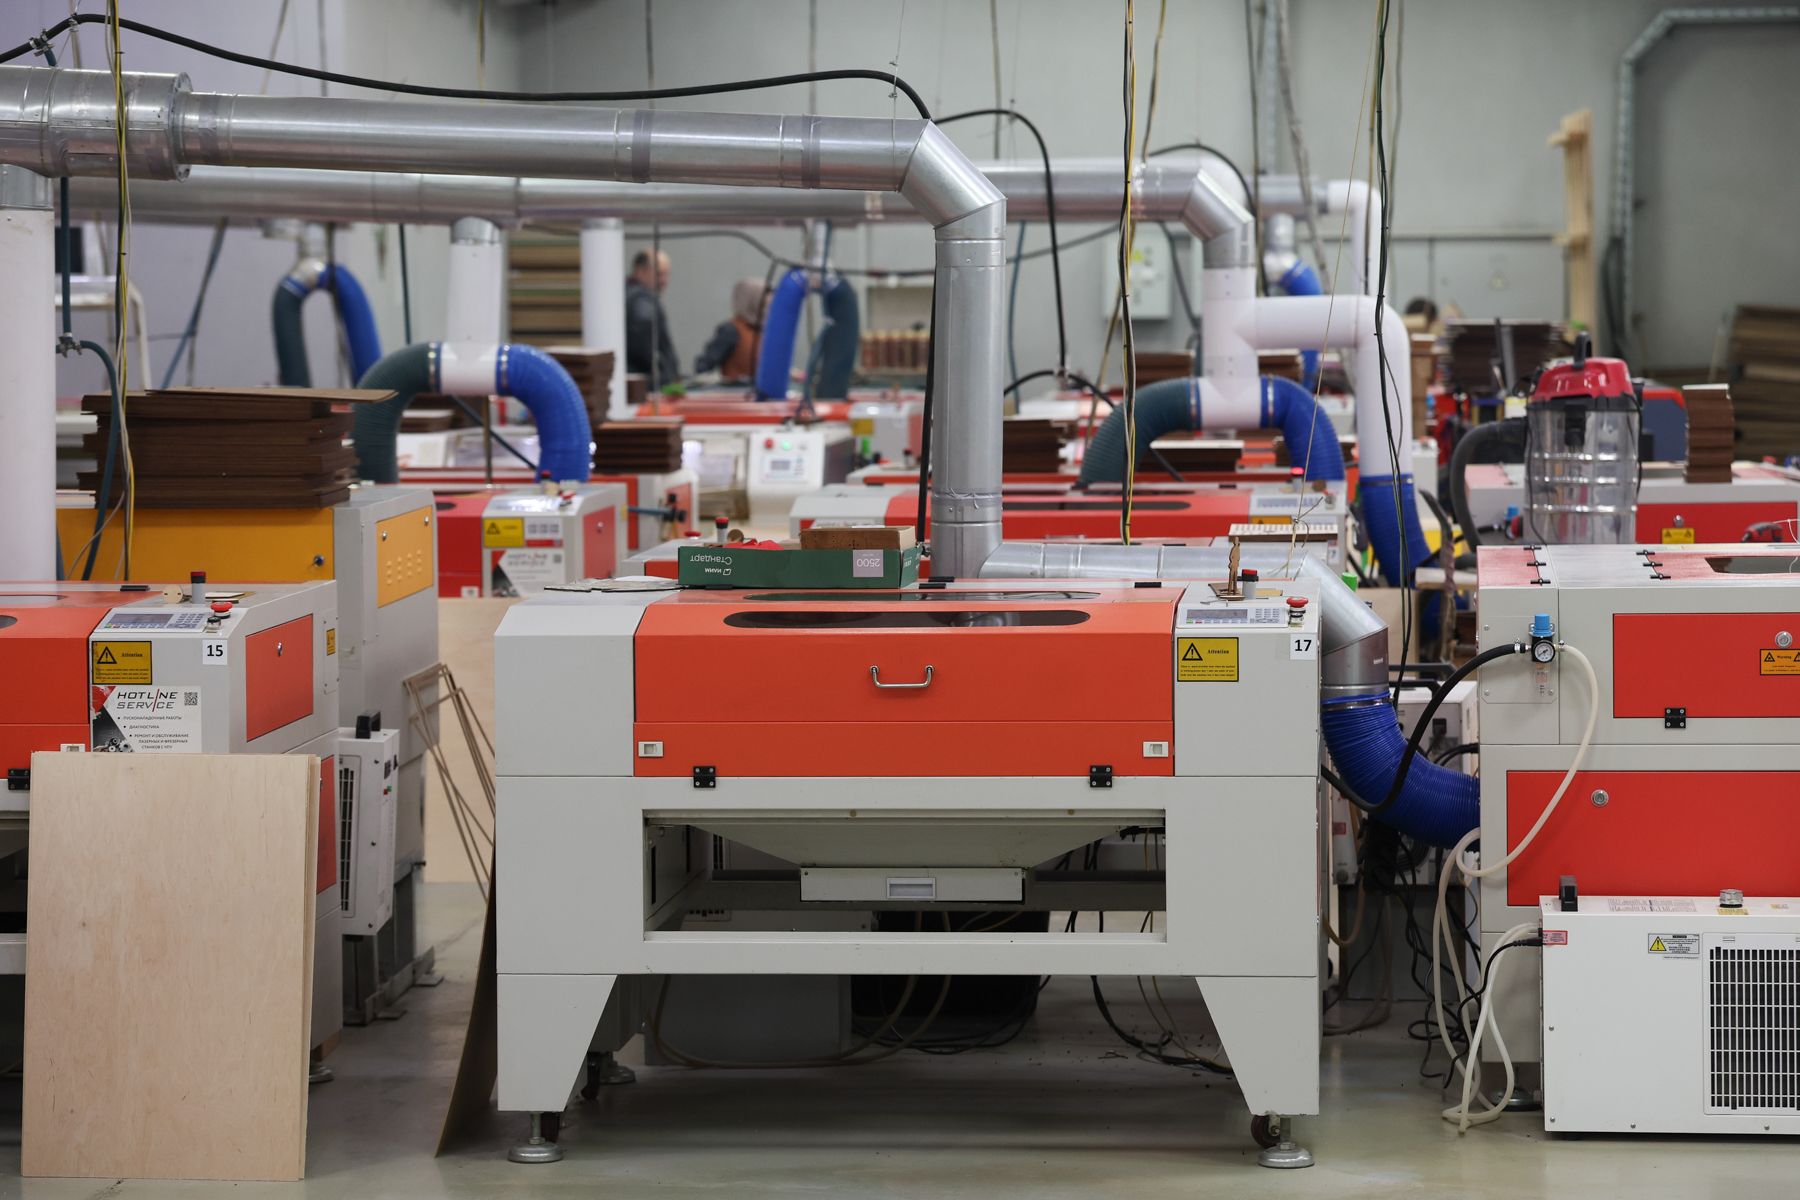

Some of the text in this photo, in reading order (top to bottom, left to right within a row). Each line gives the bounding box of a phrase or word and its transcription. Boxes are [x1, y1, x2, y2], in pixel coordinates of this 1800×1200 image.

[689, 553, 733, 566] Стандарт
[856, 558, 881, 568] 2500
[206, 644, 224, 657] 15
[1294, 639, 1312, 652] 17
[116, 701, 175, 711] SERVICE
